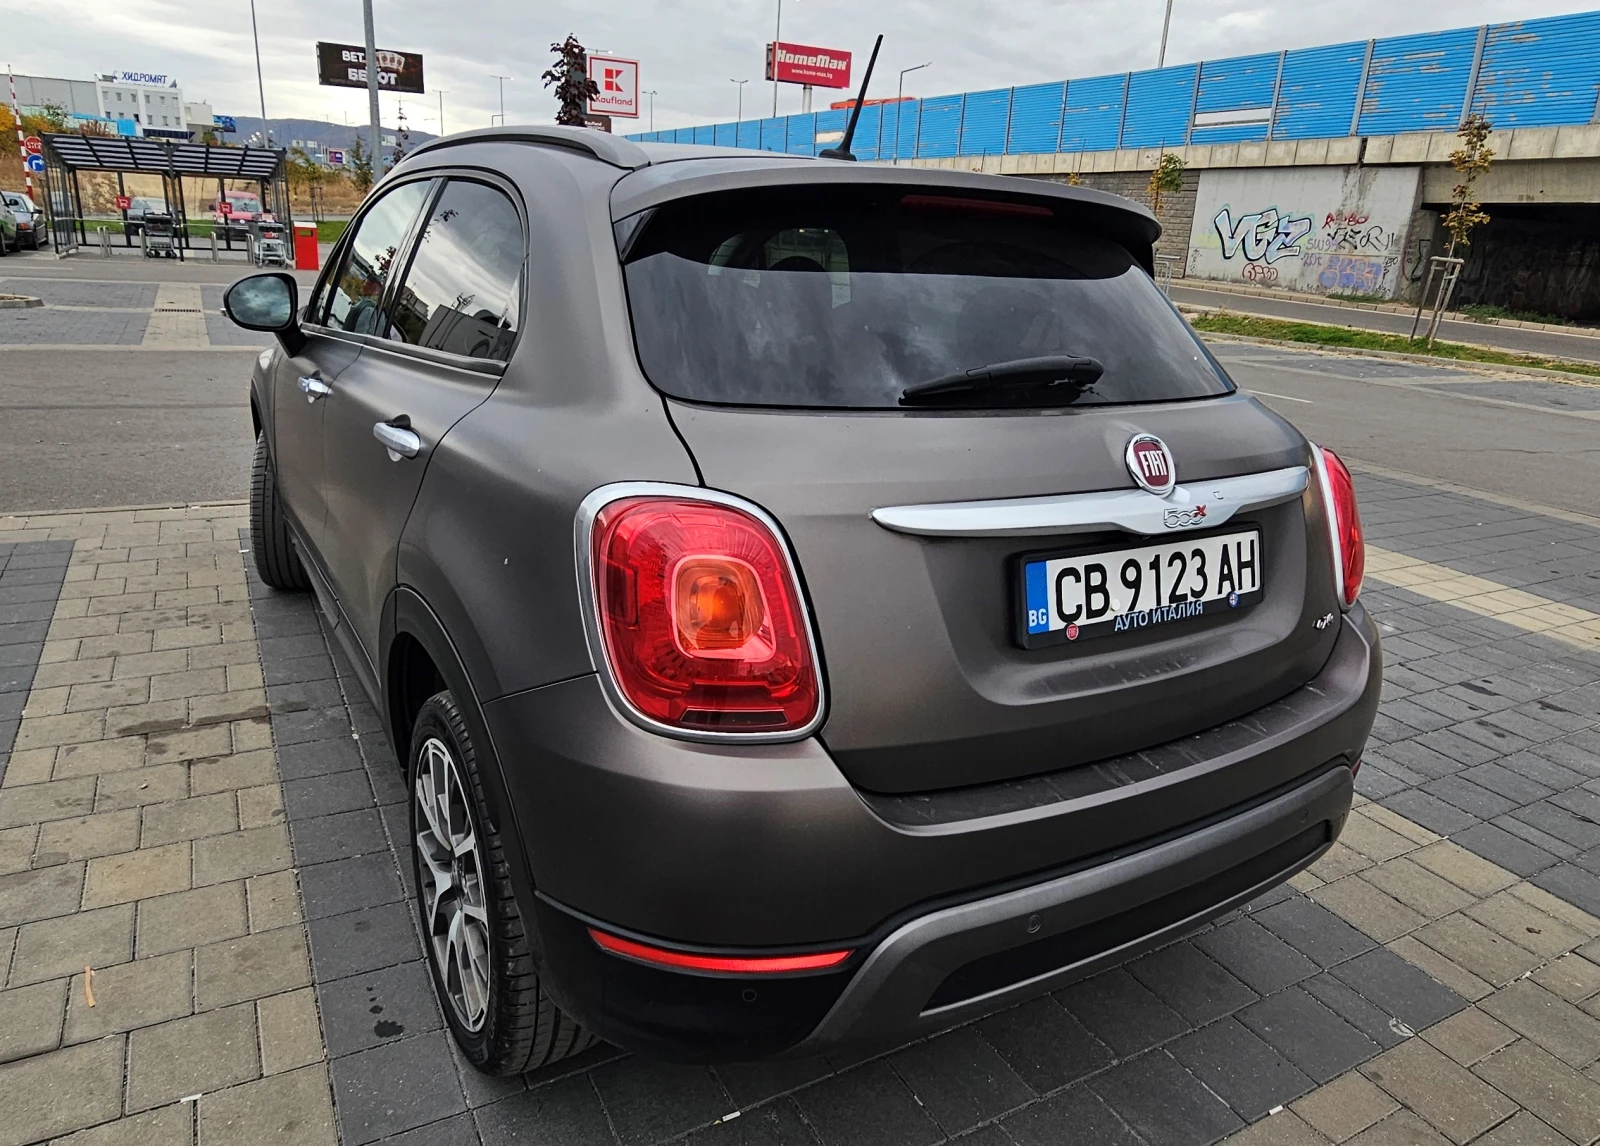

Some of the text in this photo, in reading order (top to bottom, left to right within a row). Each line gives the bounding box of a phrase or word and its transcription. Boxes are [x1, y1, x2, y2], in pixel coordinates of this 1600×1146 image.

[122, 71, 168, 84] ХИДРОМАТ
[347, 67, 398, 85] БЕОТ
[595, 95, 633, 106] Kaufland
[1137, 450, 1168, 478] FIAT
[1119, 547, 1209, 614] 9123
[1028, 607, 1048, 627] BG
[1113, 600, 1204, 633] АУТО ИТАЛИЯ
